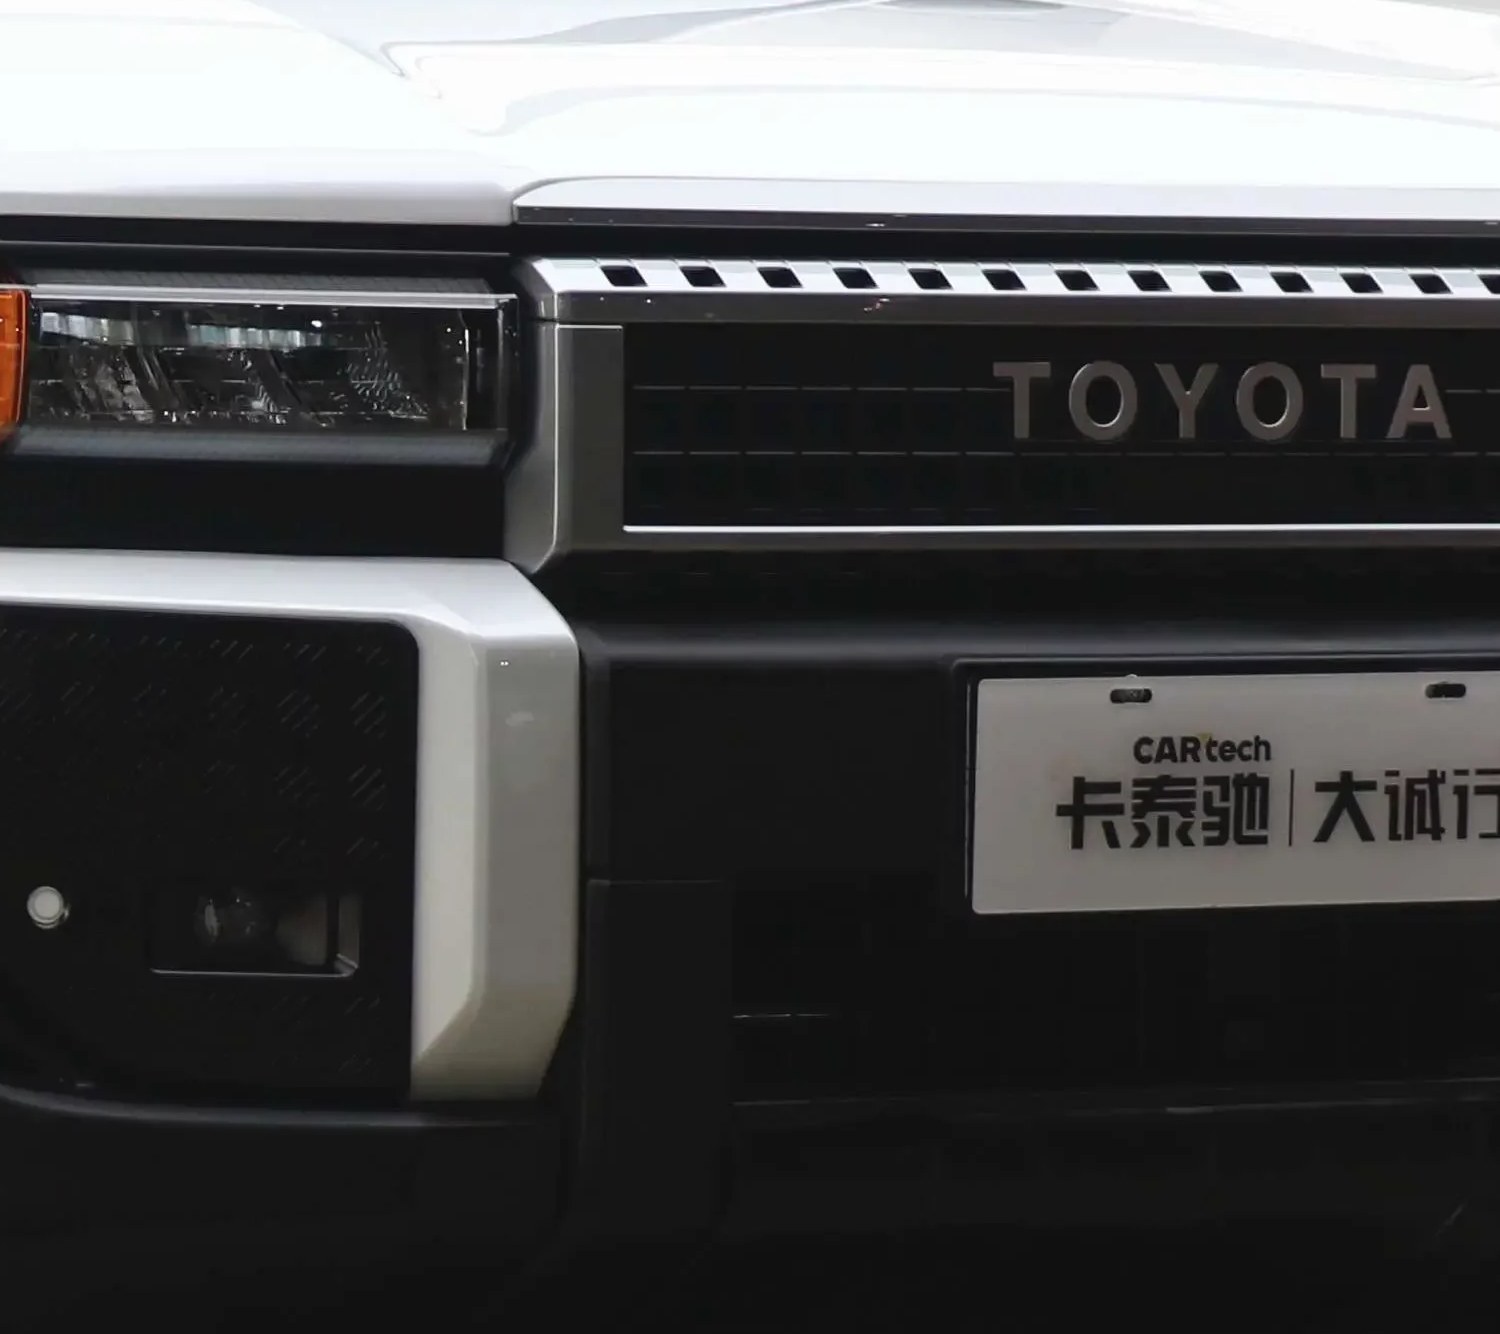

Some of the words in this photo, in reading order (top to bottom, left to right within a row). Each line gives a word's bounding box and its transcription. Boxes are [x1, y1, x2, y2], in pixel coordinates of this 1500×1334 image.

[992, 359, 1452, 442] TOYOTA
[1132, 735, 1272, 765] CARtech
[1055, 771, 1270, 850] 卡泰驰
